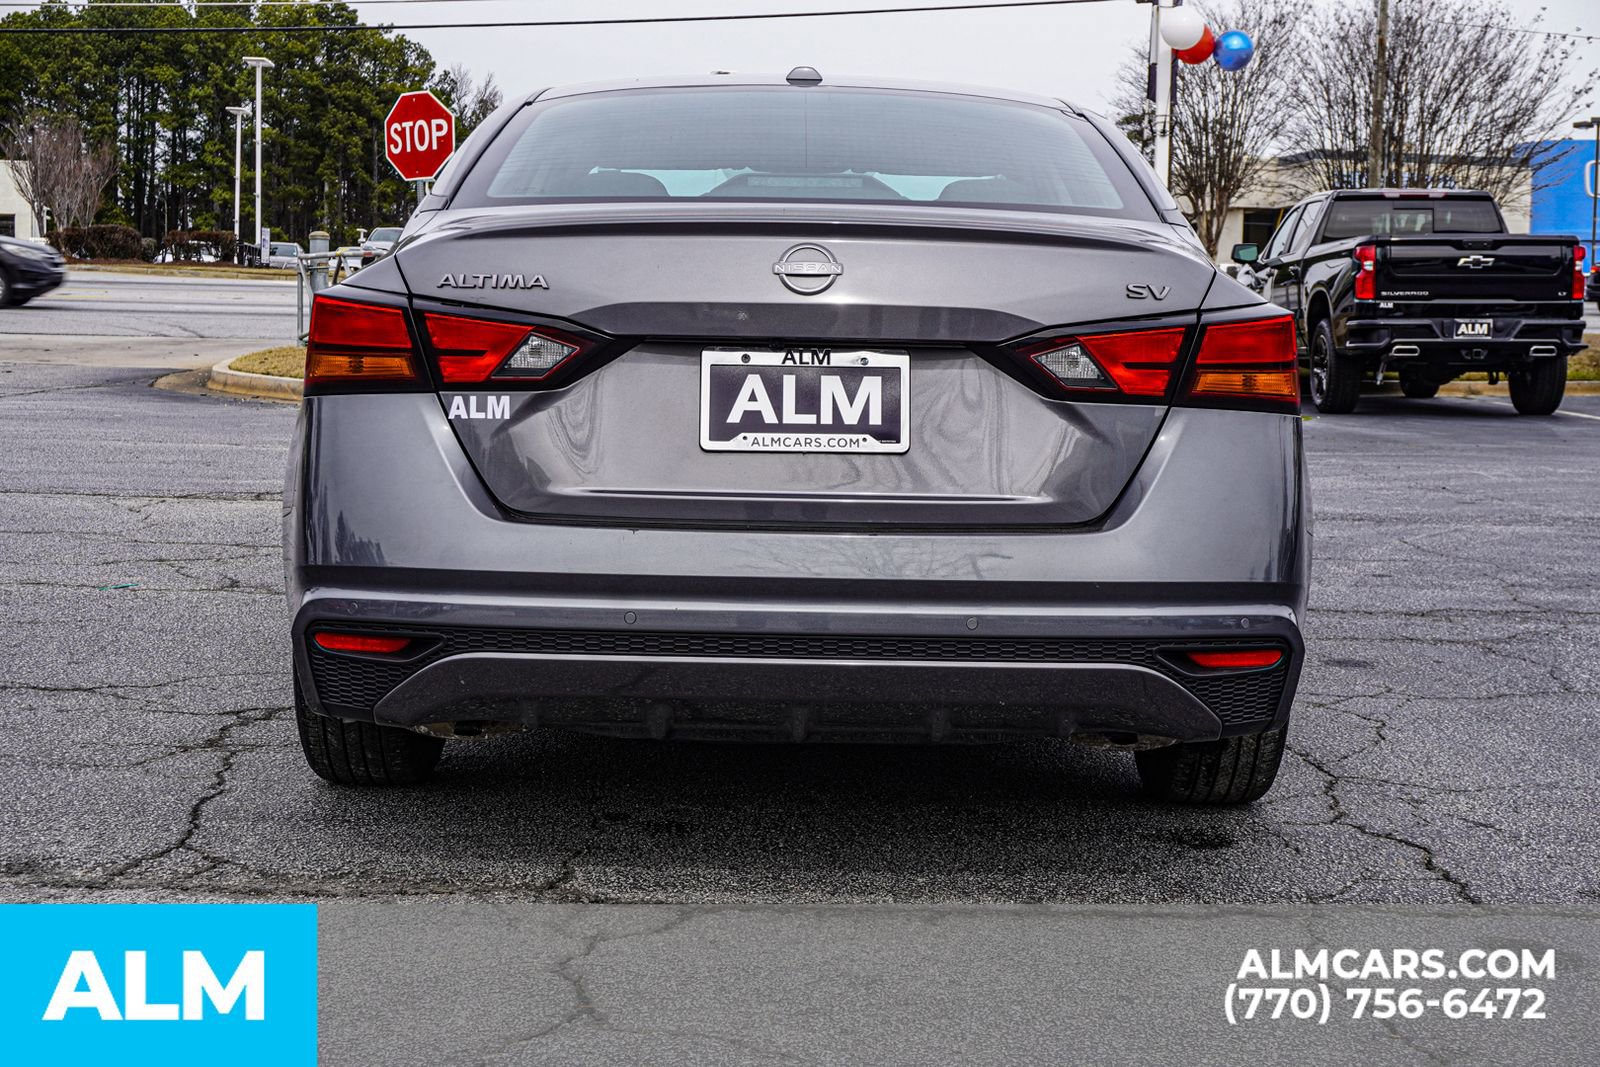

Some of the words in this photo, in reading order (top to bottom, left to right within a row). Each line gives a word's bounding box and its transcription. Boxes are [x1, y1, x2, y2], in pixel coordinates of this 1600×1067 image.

[390, 119, 449, 155] STOP
[774, 263, 842, 274] NISSAN
[437, 273, 549, 290] ALTIMA
[1126, 283, 1172, 301] SV
[1457, 323, 1488, 334] ALM
[782, 349, 831, 366] ALM
[448, 395, 511, 420] ALM
[726, 374, 882, 425] ALM
[751, 436, 860, 448] ALMCARS.COM
